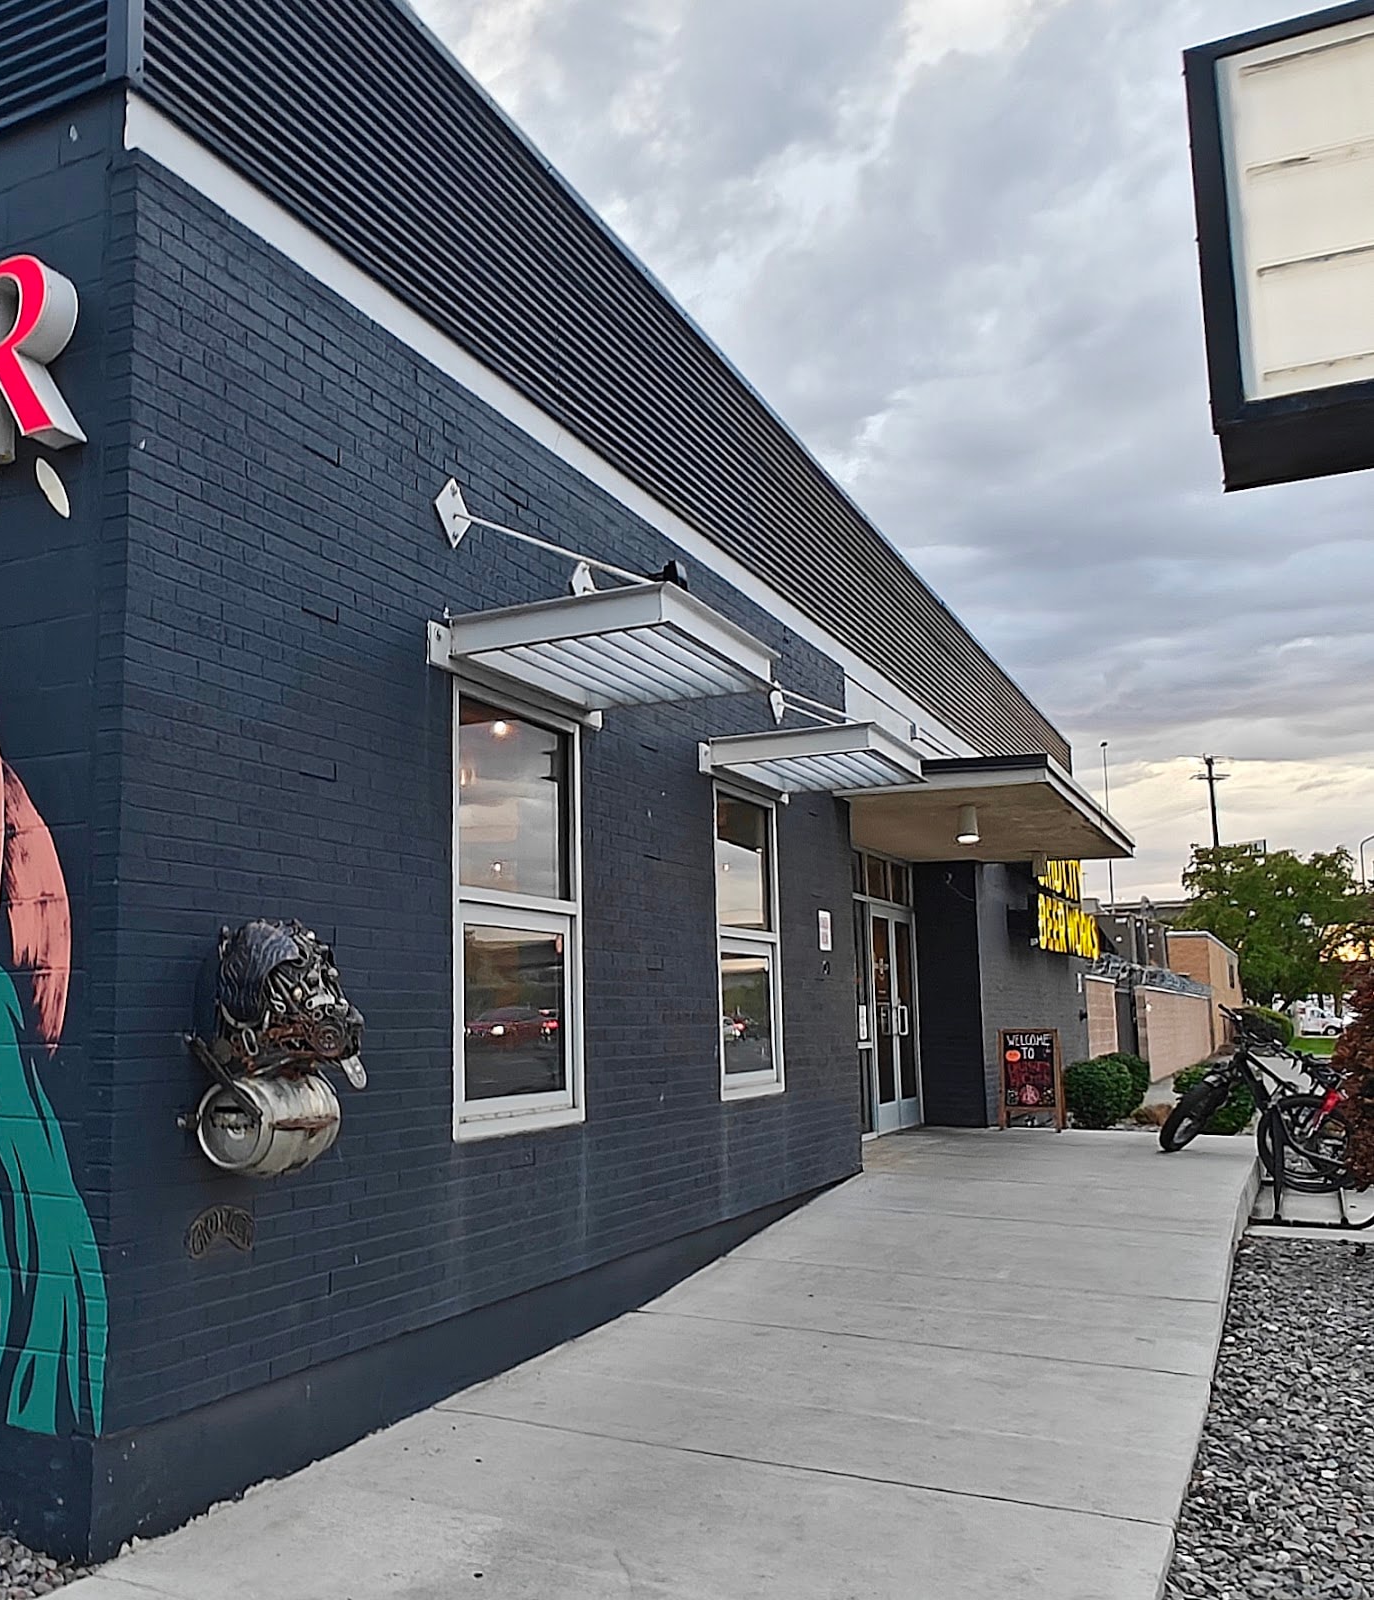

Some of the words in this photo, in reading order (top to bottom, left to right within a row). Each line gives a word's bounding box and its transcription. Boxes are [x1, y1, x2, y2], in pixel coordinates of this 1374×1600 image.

[1038, 893, 1067, 954] BEER
[1006, 1033, 1052, 1047] WELCOME
[1020, 1047, 1035, 1059] TO
